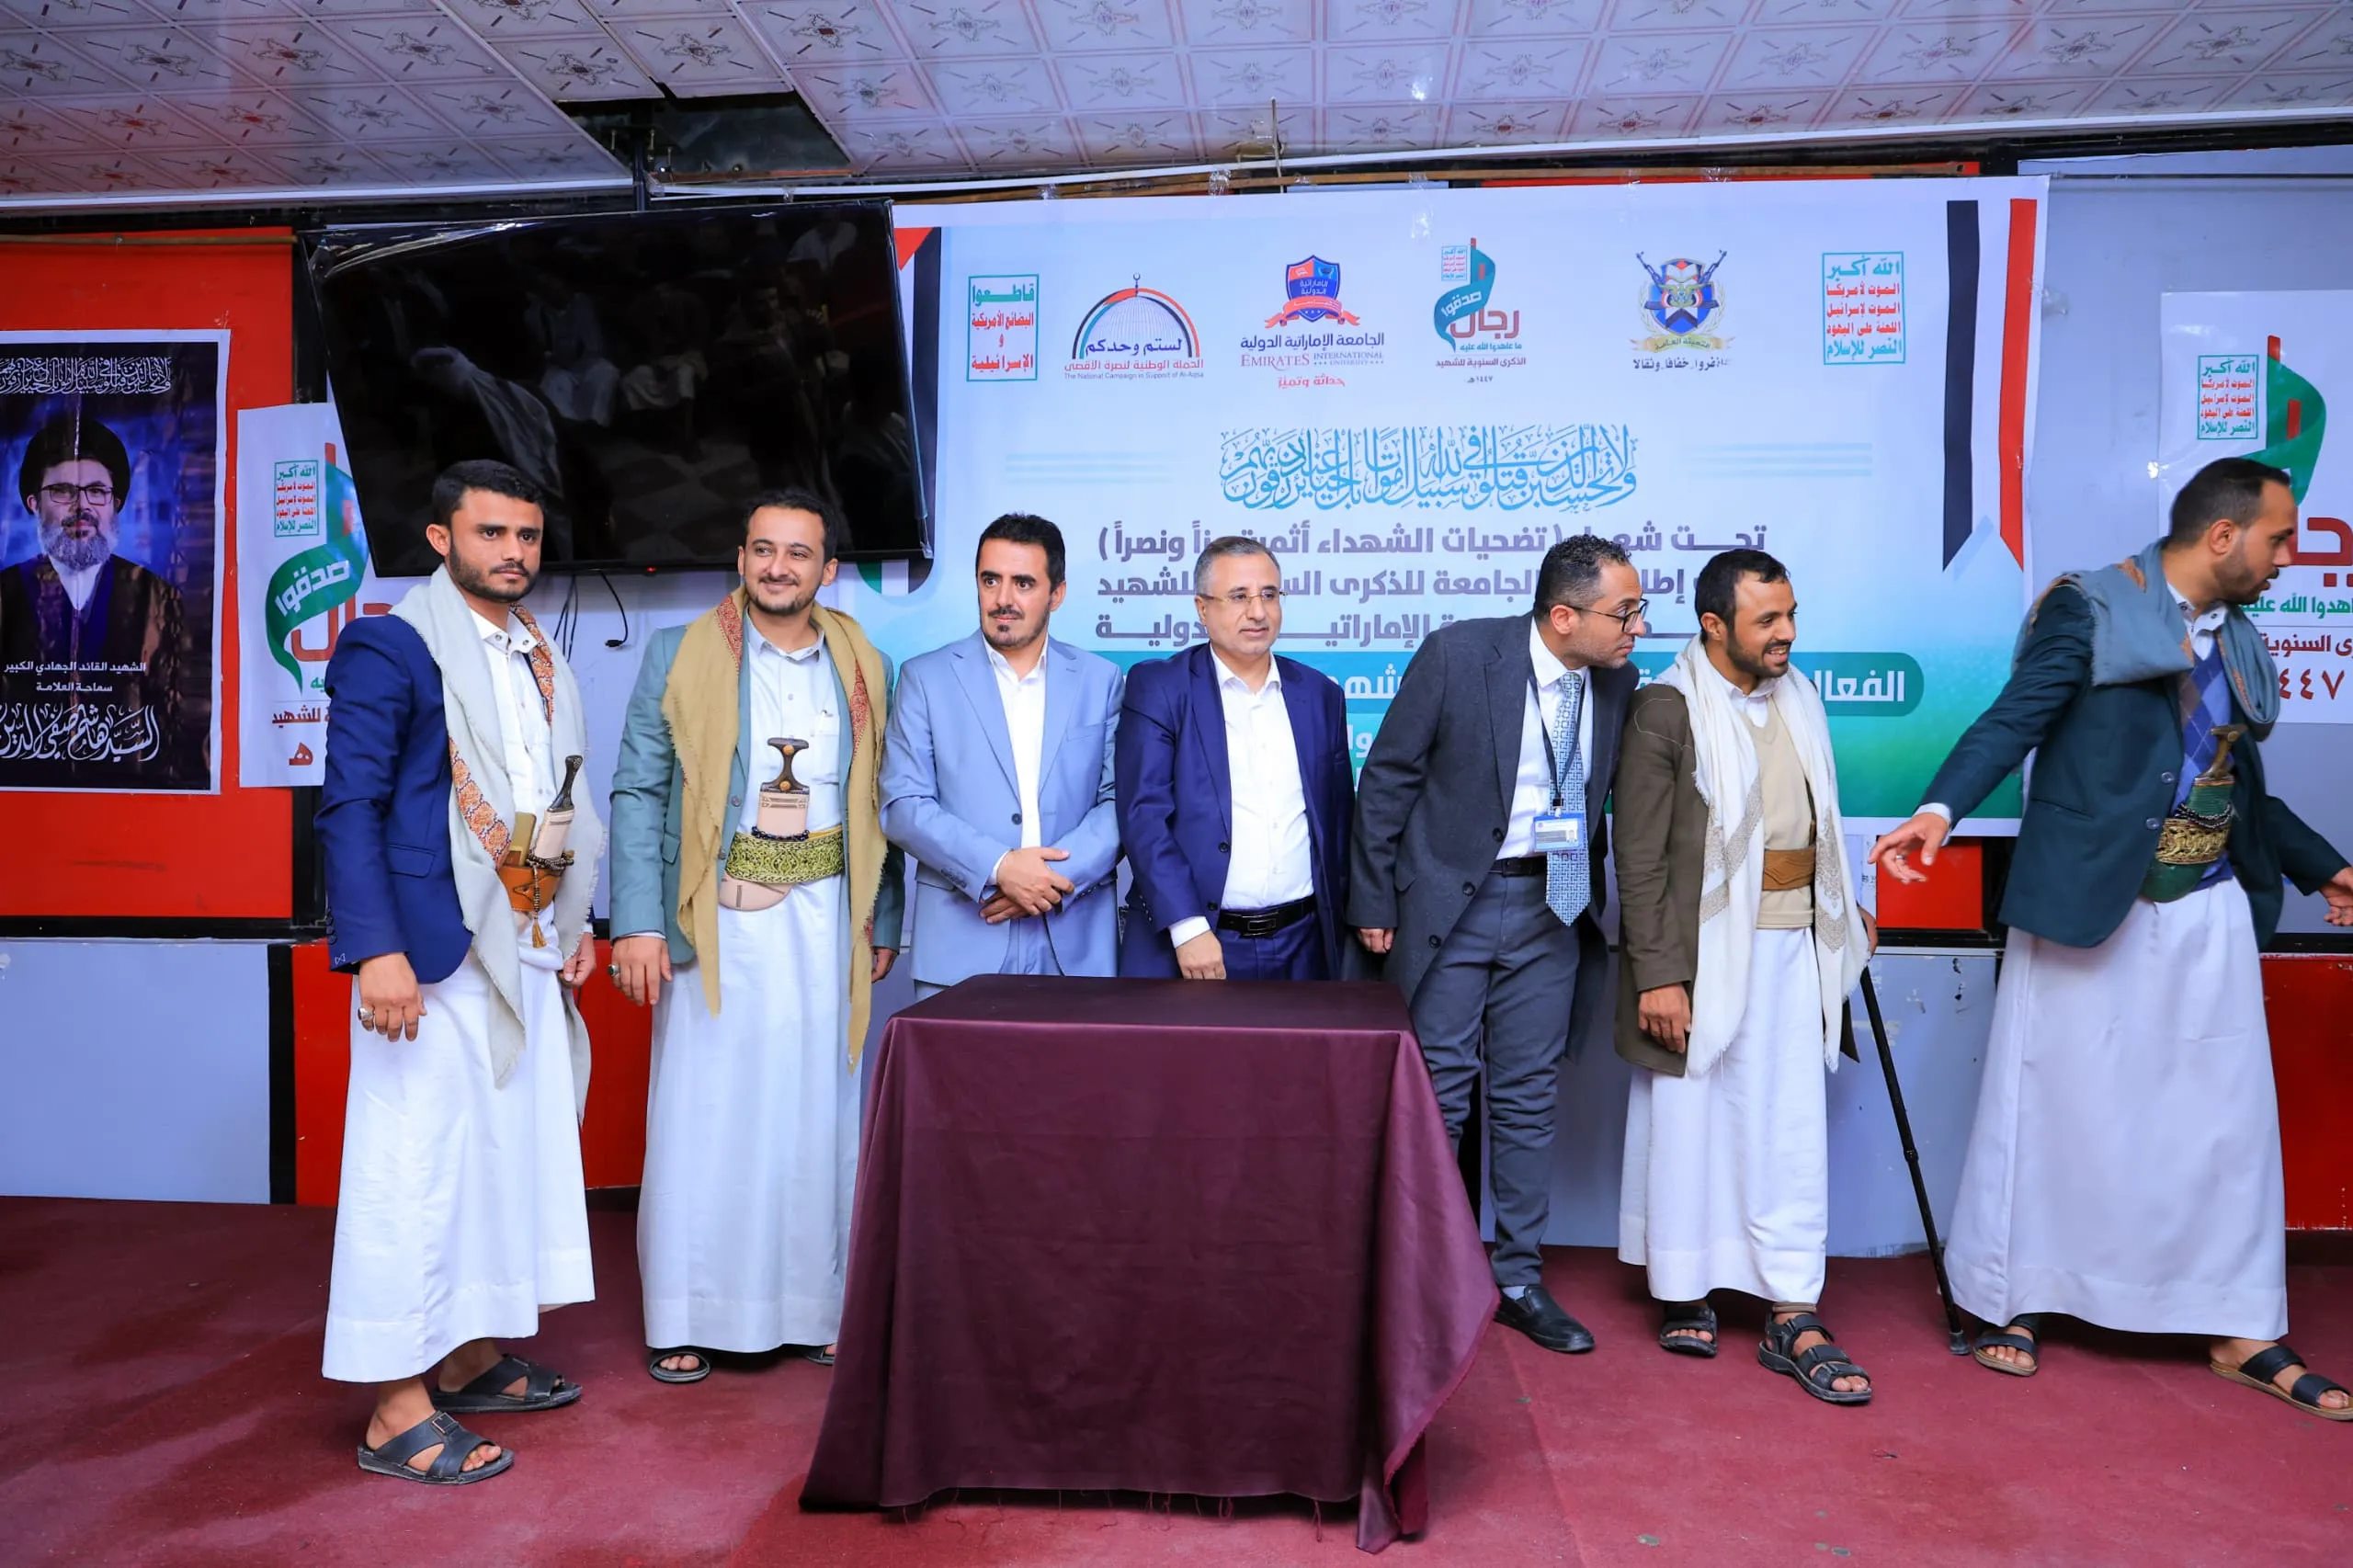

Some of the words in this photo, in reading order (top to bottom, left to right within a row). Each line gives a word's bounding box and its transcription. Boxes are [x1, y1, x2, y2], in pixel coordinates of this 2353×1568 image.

[1826, 255, 1870, 281] أكبر
[1873, 257, 1900, 275] الله
[1869, 283, 1900, 297] الموت
[1440, 290, 1483, 317] صدقوا
[1869, 301, 1900, 316] الموت
[1449, 307, 1520, 340] رجال
[1086, 338, 1140, 357] وحدكم
[1143, 337, 1183, 356] لستم
[1241, 335, 1282, 351] الدولية
[1285, 333, 1333, 351] الإماراتية
[1336, 332, 1385, 348] الجامعة
[1868, 337, 1902, 358] النصر
[1241, 353, 1310, 371] EMIRATES
[1313, 352, 1382, 360] INTERNATIONAL
[2202, 357, 2234, 378] أكبر
[2235, 360, 2255, 373] الله
[277, 463, 298, 482] أكبر
[301, 465, 315, 476] الله
[1317, 522, 1434, 553] الشهداء
[275, 560, 350, 617] صدقوا
[1097, 566, 1196, 604] للشهيد
[1329, 569, 1426, 604] للذكرى
[2279, 593, 2307, 613] الله
[2312, 596, 2353, 619] هدوا
[1095, 614, 1208, 647] دولية
[1279, 613, 1430, 649] الإماراتي
[4, 661, 34, 674] الكبير
[35, 661, 77, 676] الجهادي
[110, 662, 147, 675] الشهيد
[36, 681, 75, 692] العلامة
[75, 682, 113, 692] سماحة
[1813, 669, 1905, 702] الفعال
[2279, 667, 2345, 700] ٤٤٧
[272, 705, 321, 729] للشهيد
